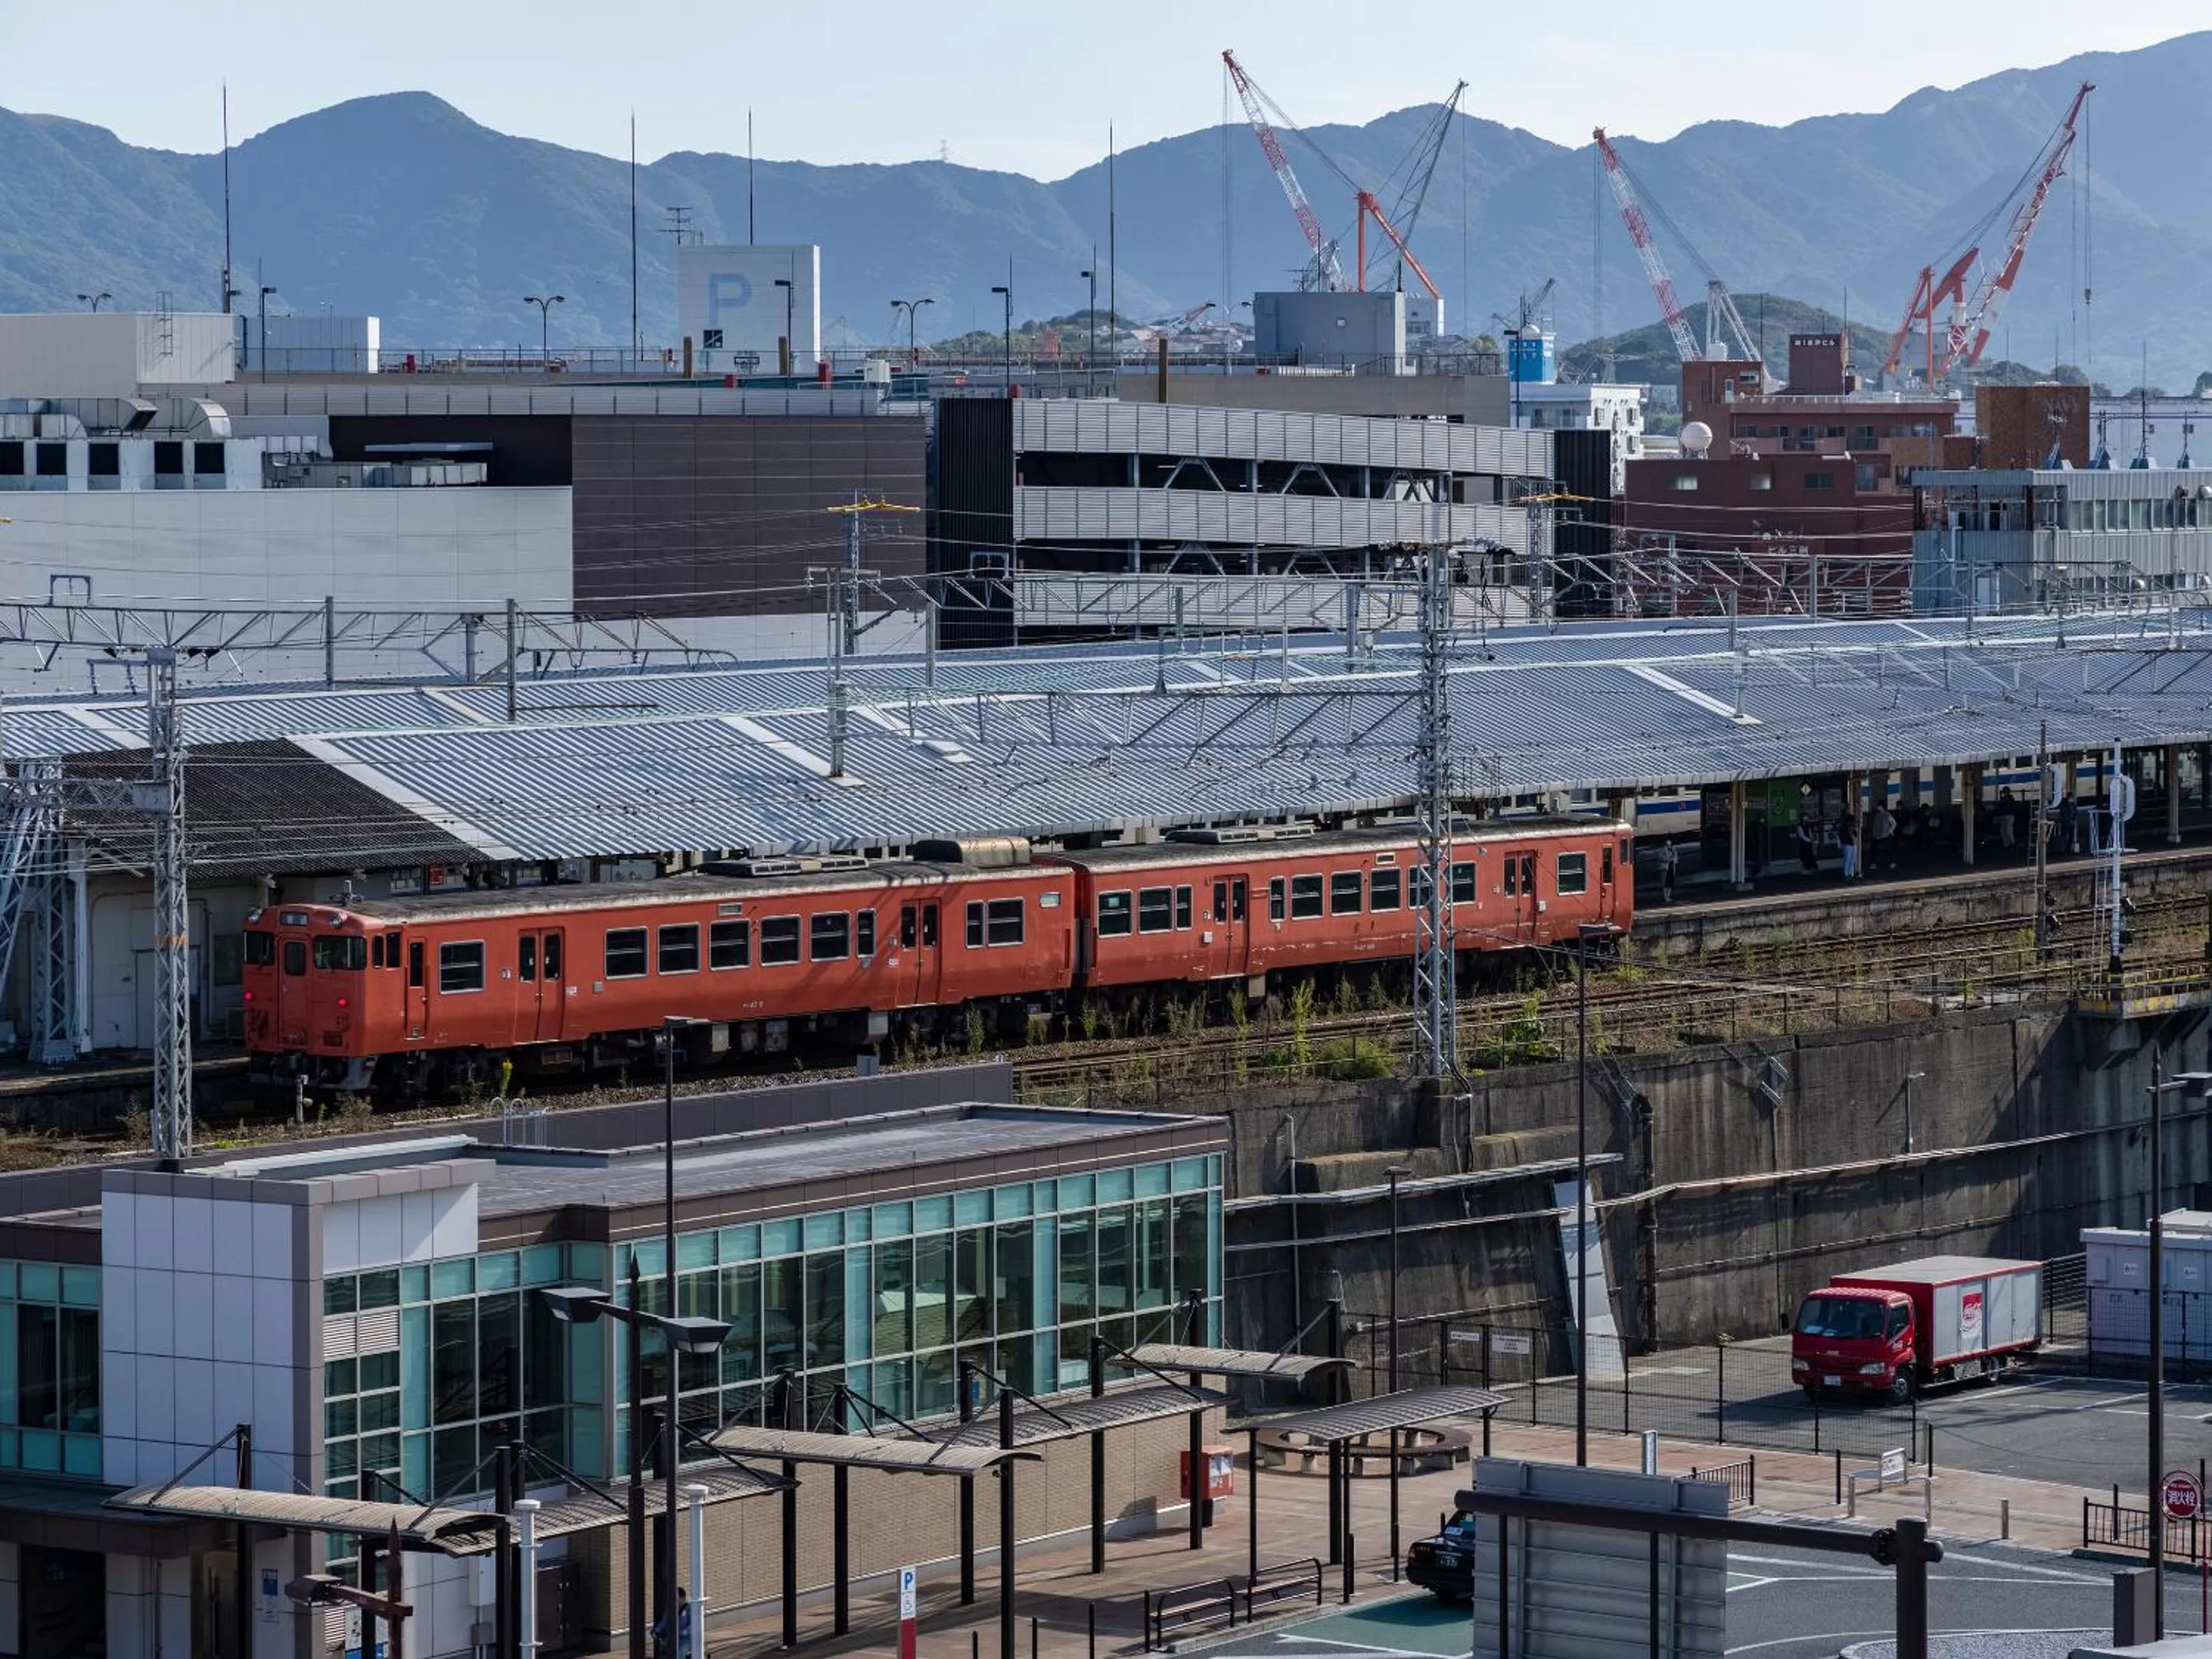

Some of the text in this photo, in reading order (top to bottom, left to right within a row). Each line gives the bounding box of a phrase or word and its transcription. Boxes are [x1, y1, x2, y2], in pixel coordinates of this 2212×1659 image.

[709, 273, 752, 326] P
[2167, 1490, 2197, 1506] 消火栓
[905, 1571, 913, 1590] P
